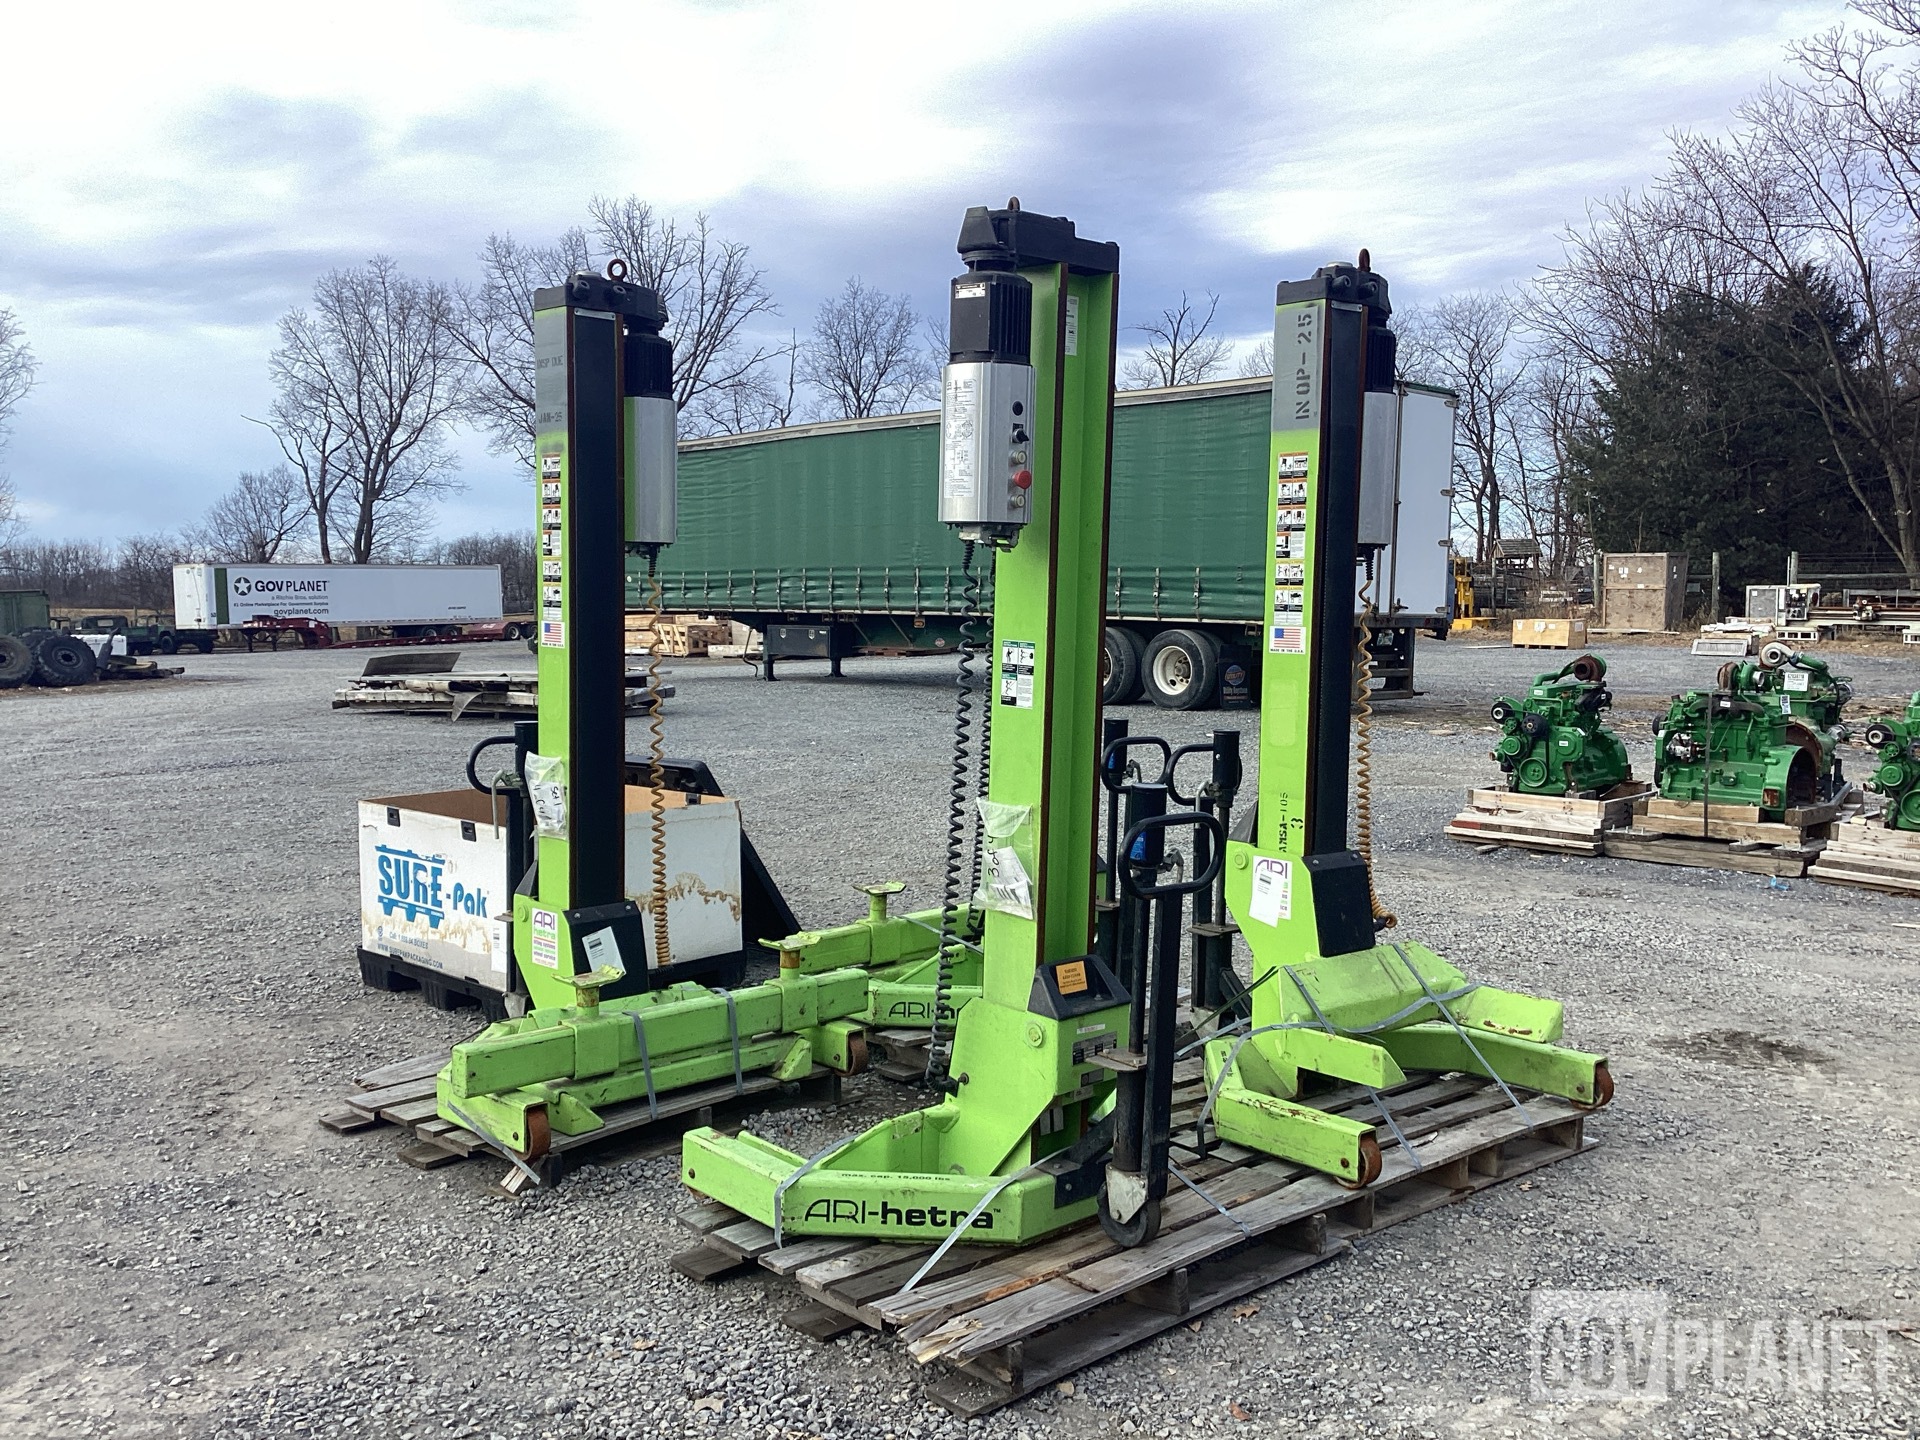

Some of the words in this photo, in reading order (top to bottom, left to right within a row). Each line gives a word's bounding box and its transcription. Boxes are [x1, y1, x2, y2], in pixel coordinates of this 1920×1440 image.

[551, 355, 564, 367] DUE
[254, 580, 328, 592] GOVPLANET
[273, 607, 329, 616] govplanet.com
[533, 911, 555, 930] ARI
[533, 927, 556, 939] hetra
[804, 1198, 994, 1229] ARI-hetra
